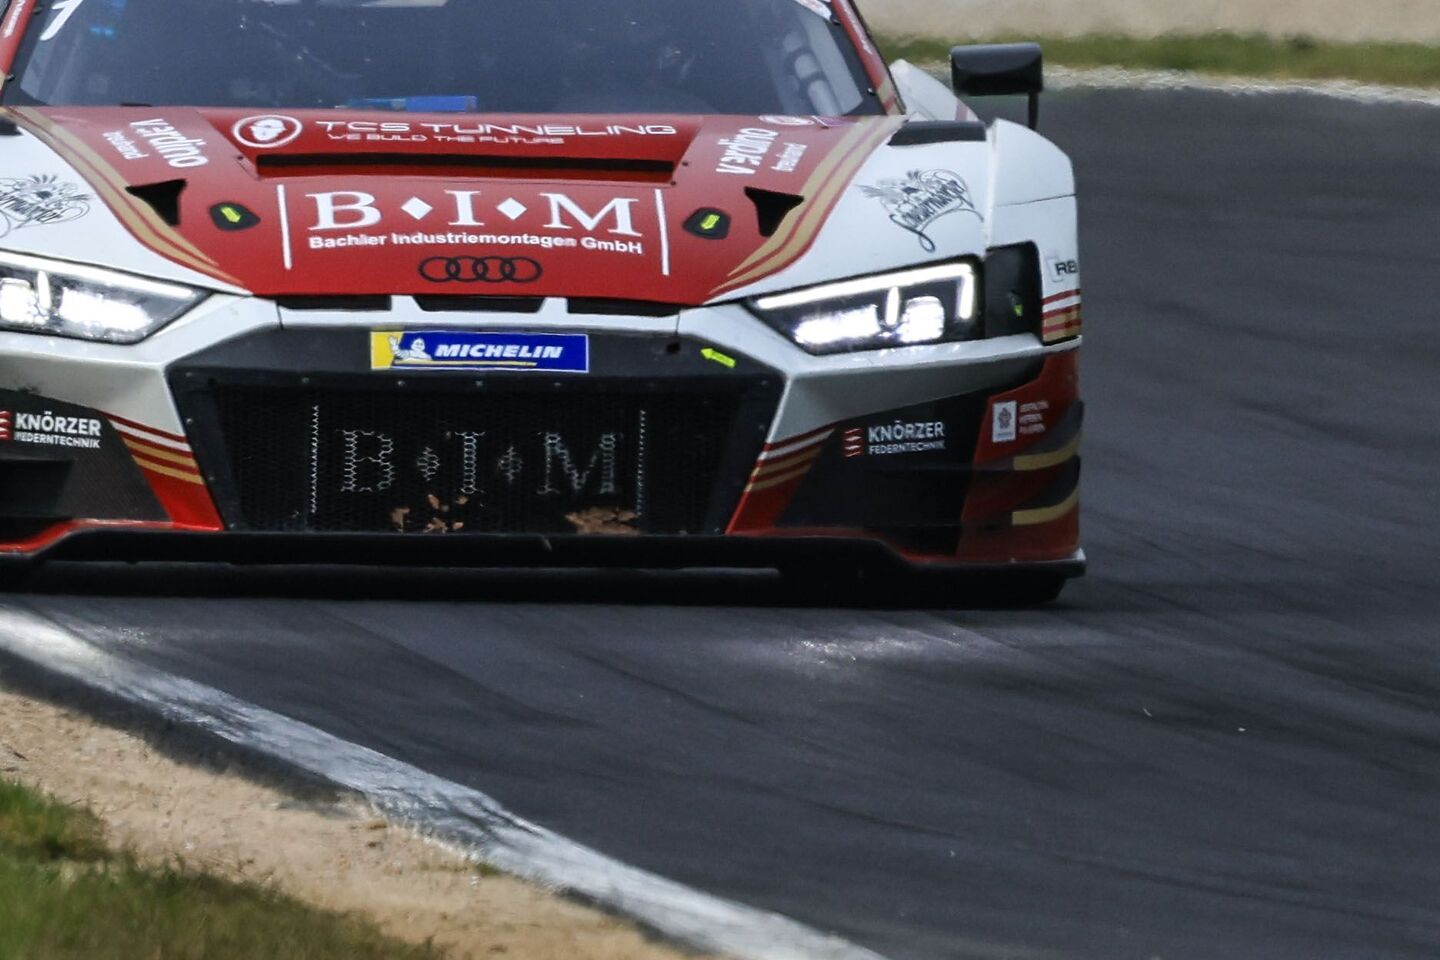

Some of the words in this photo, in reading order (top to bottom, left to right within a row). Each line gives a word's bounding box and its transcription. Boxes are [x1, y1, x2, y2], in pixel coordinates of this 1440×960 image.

[315, 120, 410, 133] TCS
[419, 122, 677, 136] TUNNELING
[327, 133, 357, 141] WE
[365, 133, 428, 142] BUILD
[432, 135, 475, 144] THE
[479, 135, 565, 145] FUTURE
[580, 236, 644, 254] GmbH
[434, 343, 565, 359] MICHELIN
[15, 410, 102, 437] KNÖRZER
